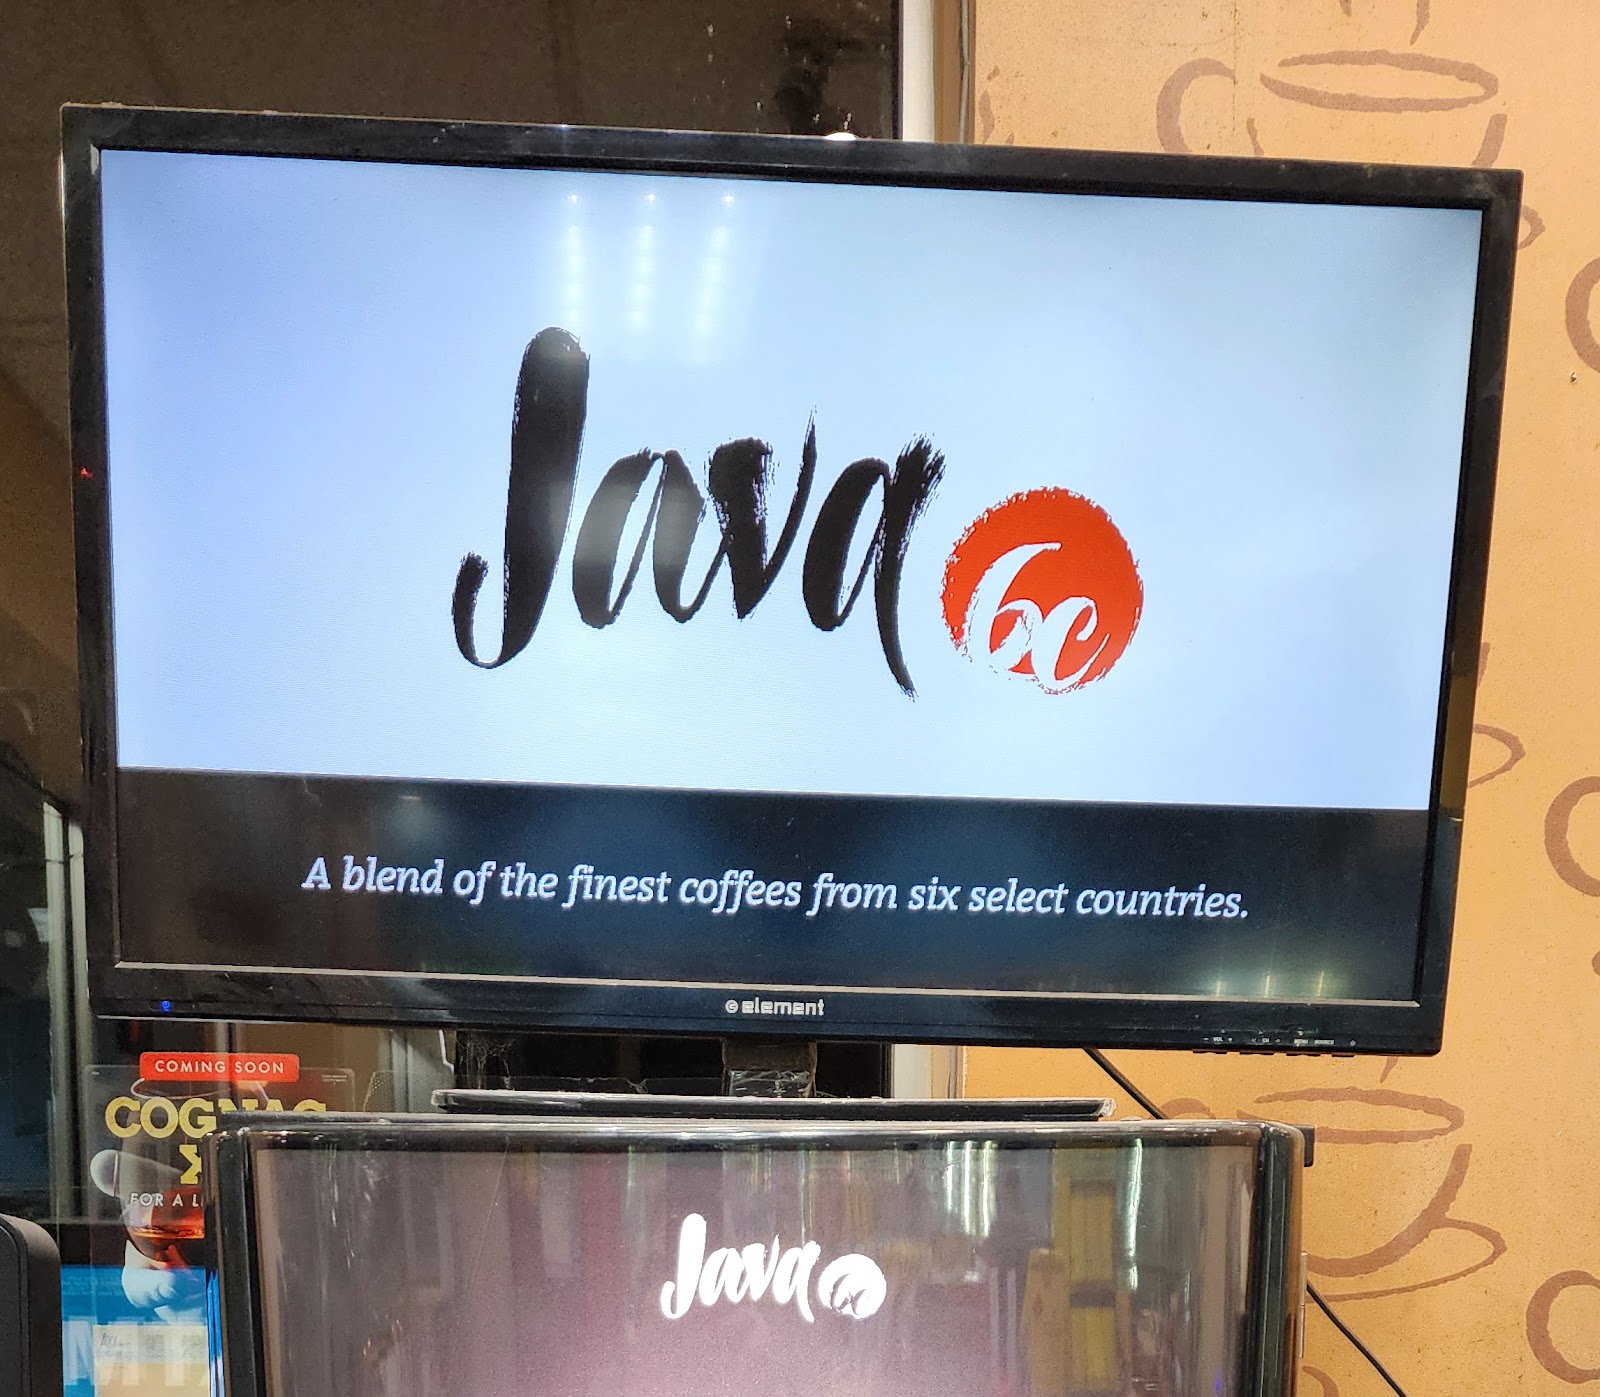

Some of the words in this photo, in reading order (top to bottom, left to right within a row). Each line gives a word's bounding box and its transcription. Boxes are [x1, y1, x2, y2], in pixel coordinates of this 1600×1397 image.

[451, 327, 945, 700] Java
[301, 856, 331, 890] A
[342, 855, 445, 894] blend
[453, 860, 496, 905] of
[499, 861, 559, 898] the
[562, 864, 671, 908] finest
[679, 869, 801, 914] coffees
[805, 872, 898, 917] from
[908, 876, 961, 912] six
[968, 877, 1068, 914] select
[1076, 883, 1249, 918] countries.
[741, 997, 825, 1016] element
[154, 1059, 226, 1074] COMING
[234, 1060, 285, 1074] SOON
[130, 1192, 164, 1207] FOR
[172, 1193, 183, 1207] A
[660, 1213, 821, 1323] Java
